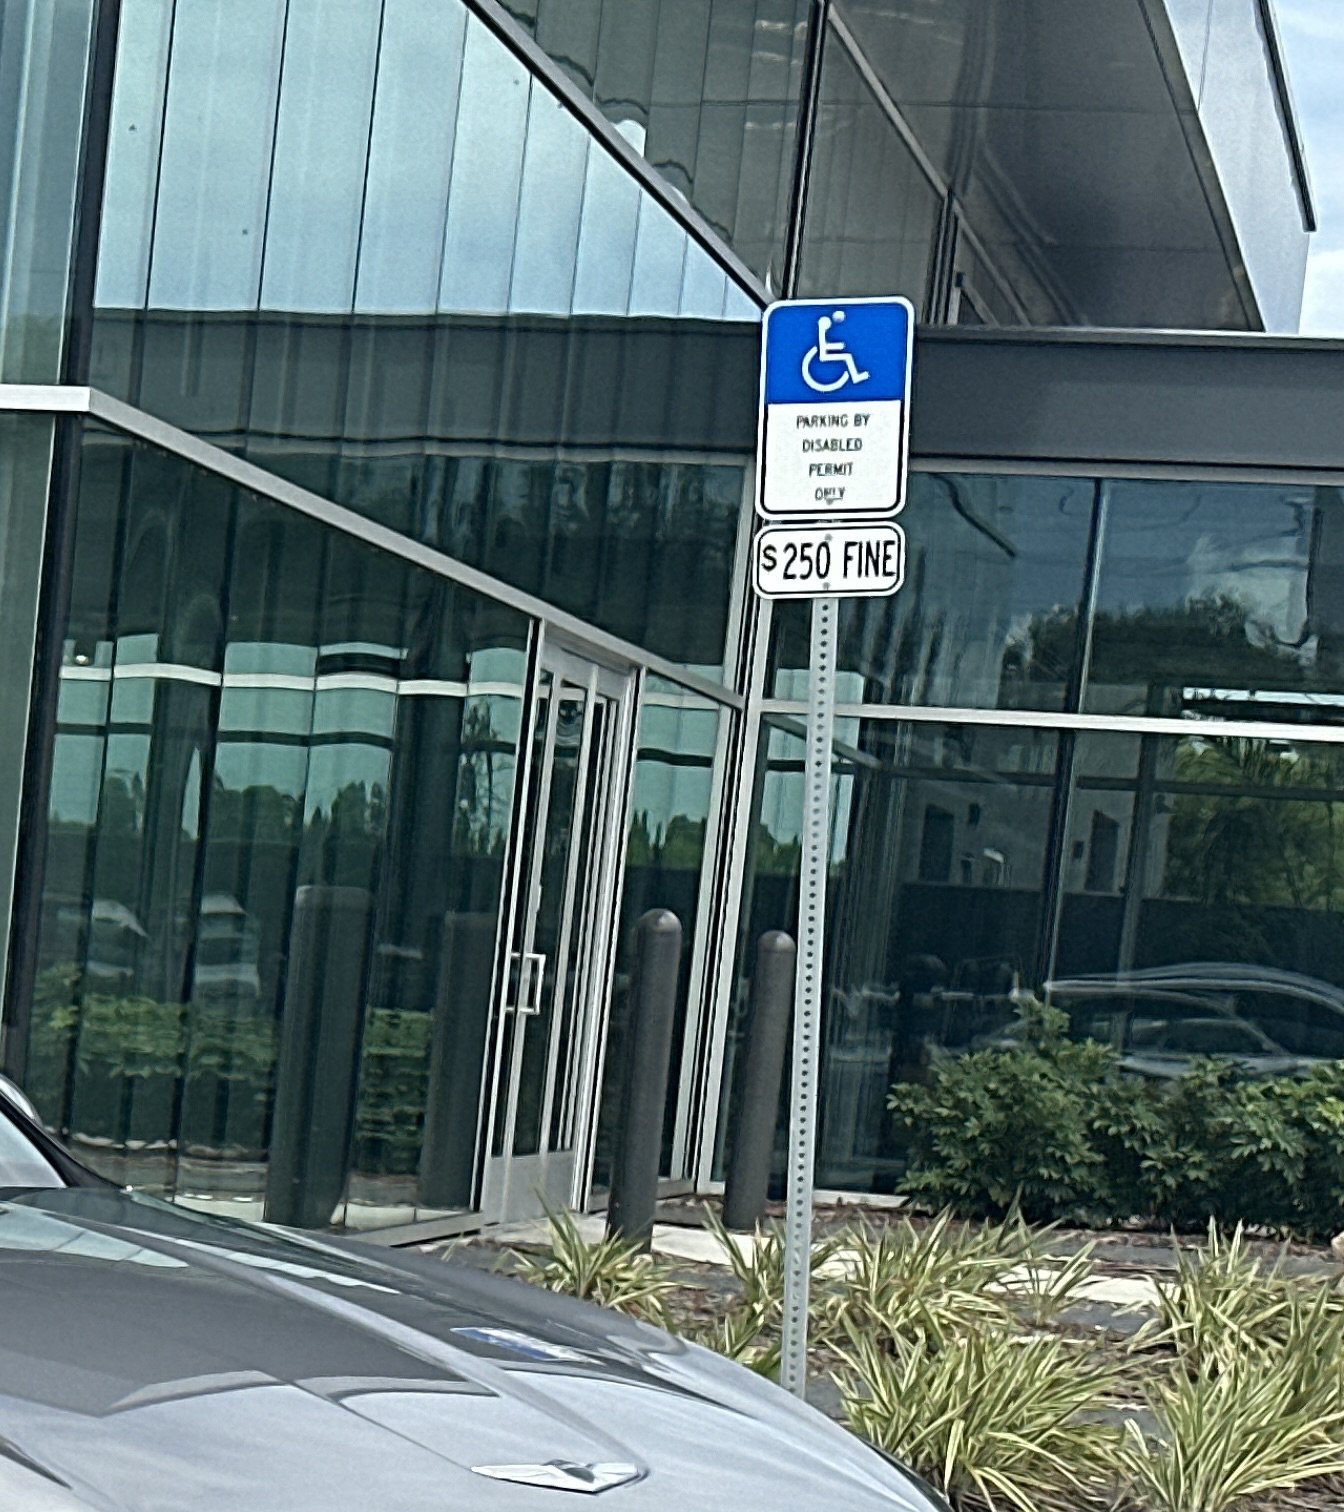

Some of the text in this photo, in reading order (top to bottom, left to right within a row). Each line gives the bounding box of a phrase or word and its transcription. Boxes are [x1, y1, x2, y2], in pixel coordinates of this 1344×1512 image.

[796, 413, 870, 429] PARKING BY
[802, 438, 863, 453] DISABLED
[808, 461, 853, 477] PERMIT
[814, 486, 846, 501] ONLY
[761, 540, 896, 580] $250 FINE
